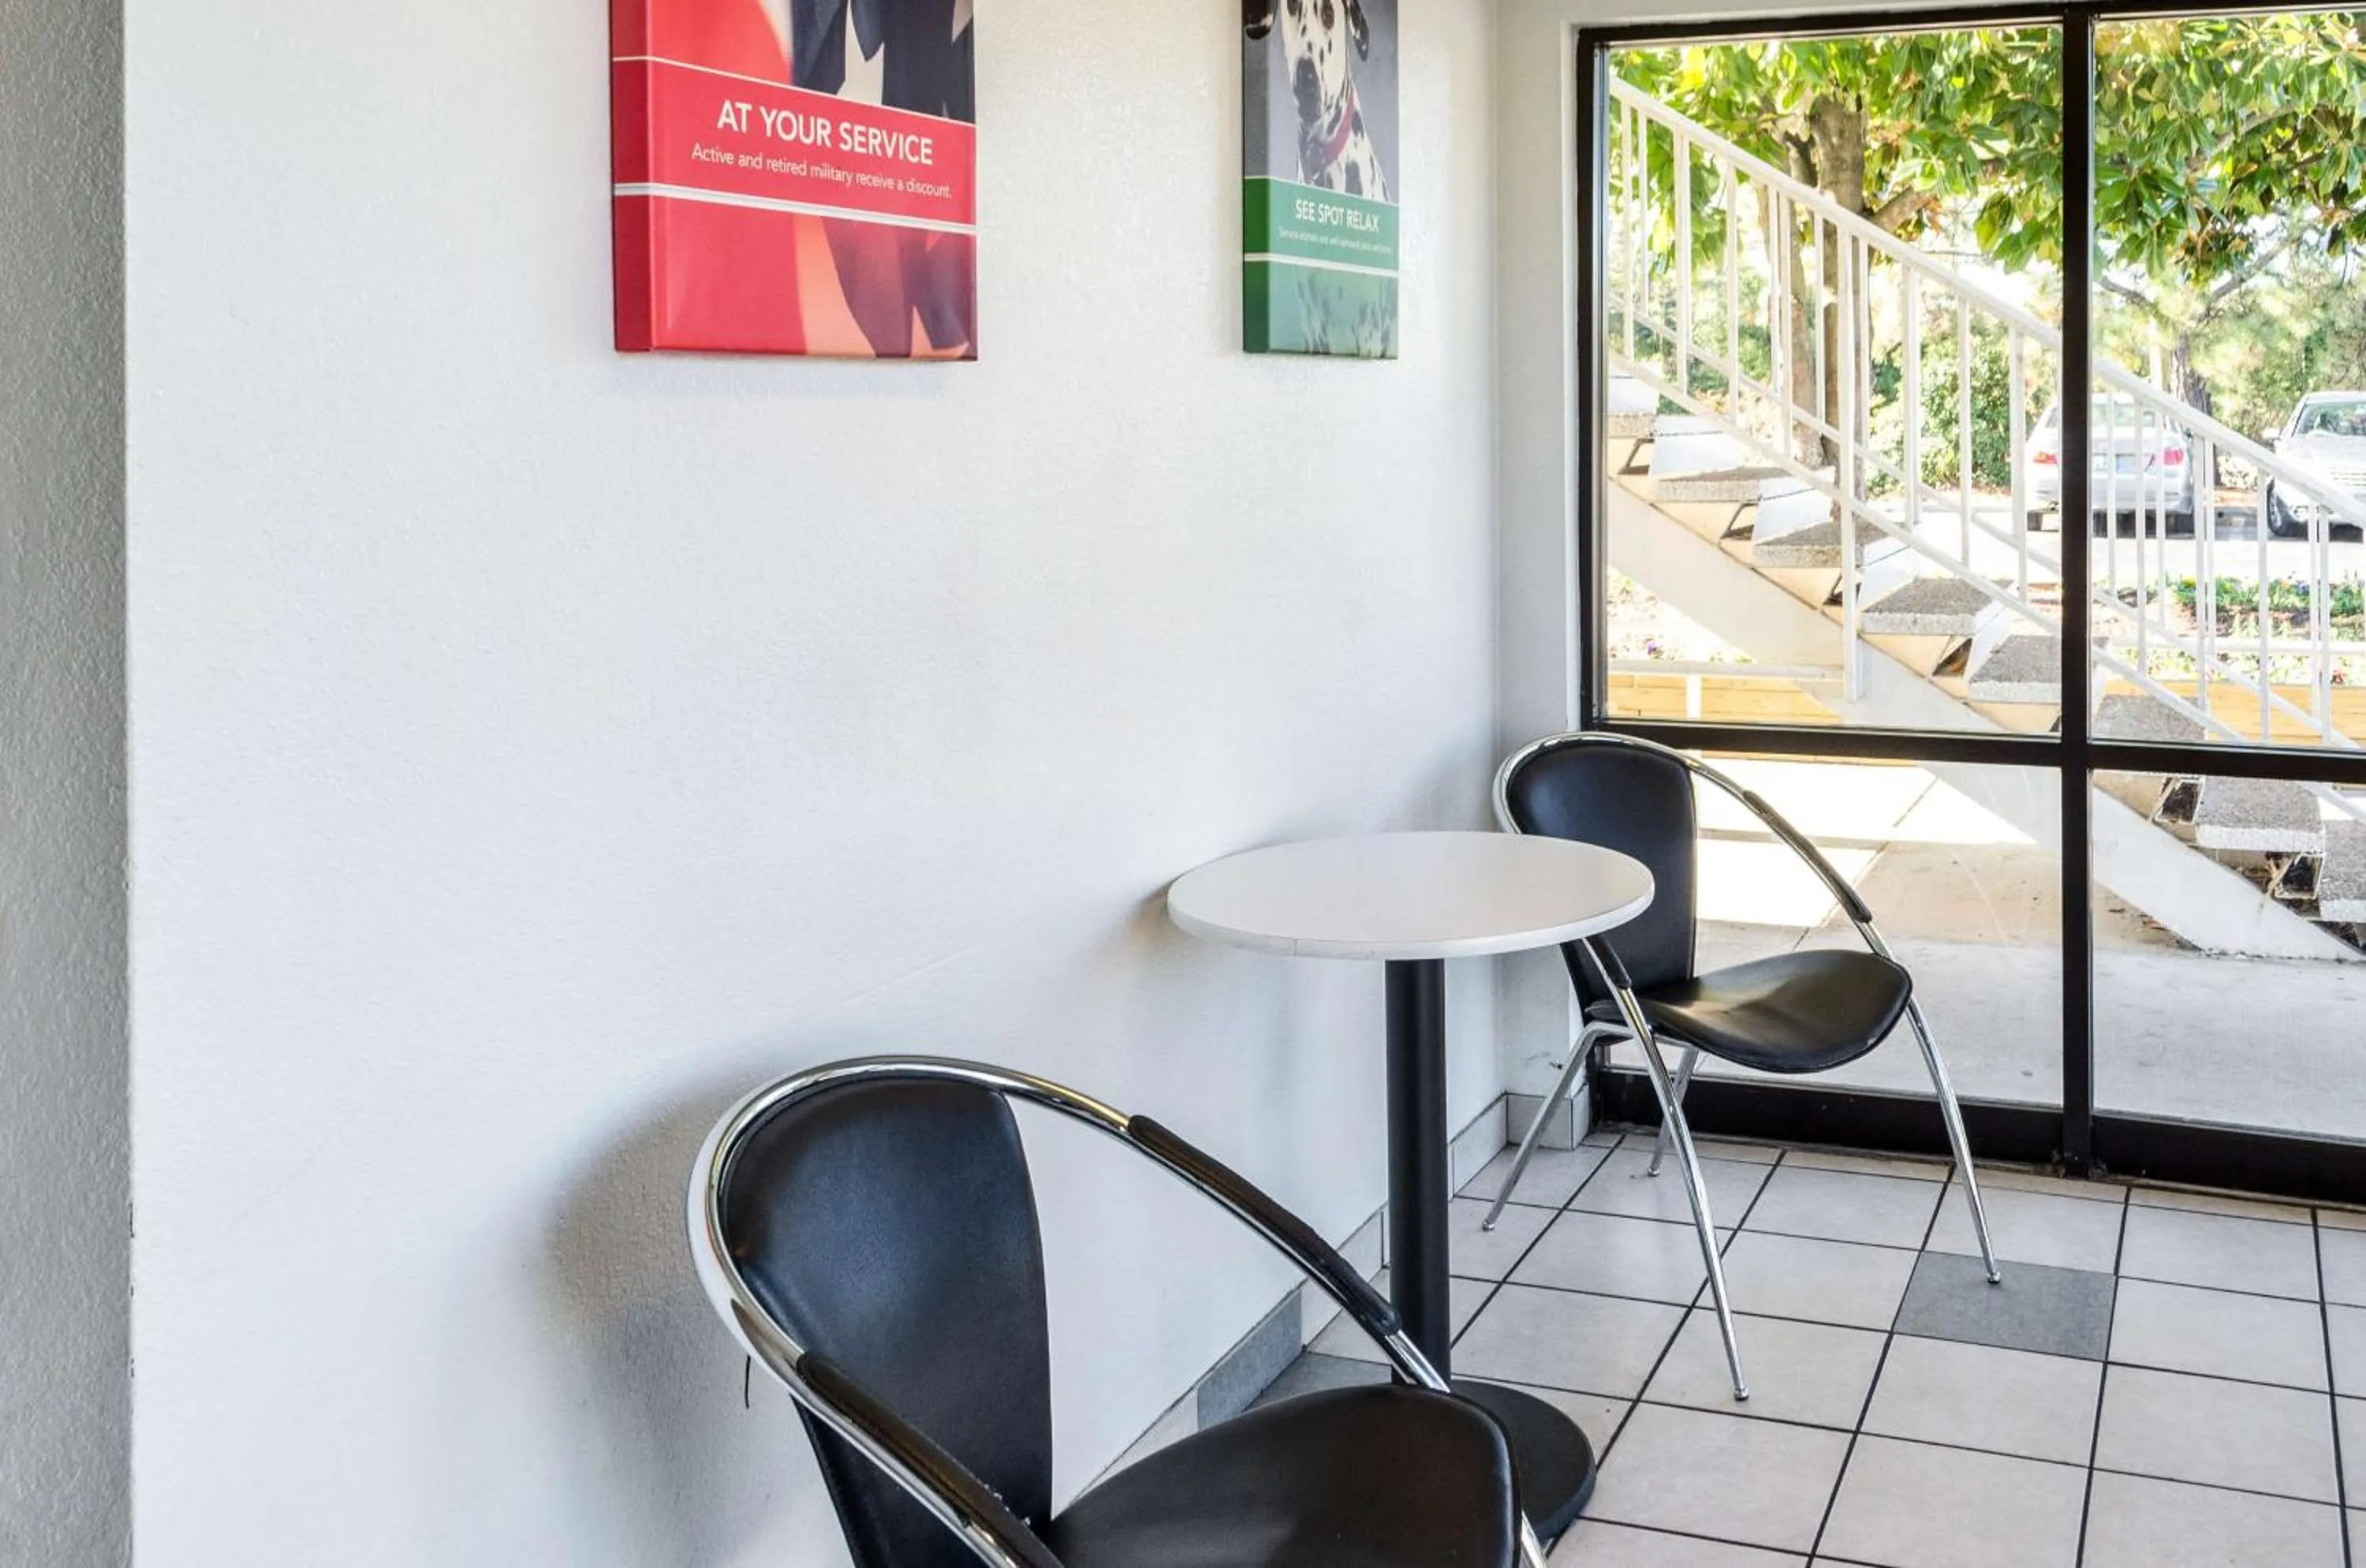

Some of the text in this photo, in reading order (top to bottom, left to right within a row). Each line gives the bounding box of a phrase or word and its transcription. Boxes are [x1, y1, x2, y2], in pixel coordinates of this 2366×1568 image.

[717, 100, 934, 166] AT YOUR SERVICE
[691, 142, 952, 199] Active and retired military receive a discount.
[1295, 199, 1379, 233] SEE SPOT RELAX
